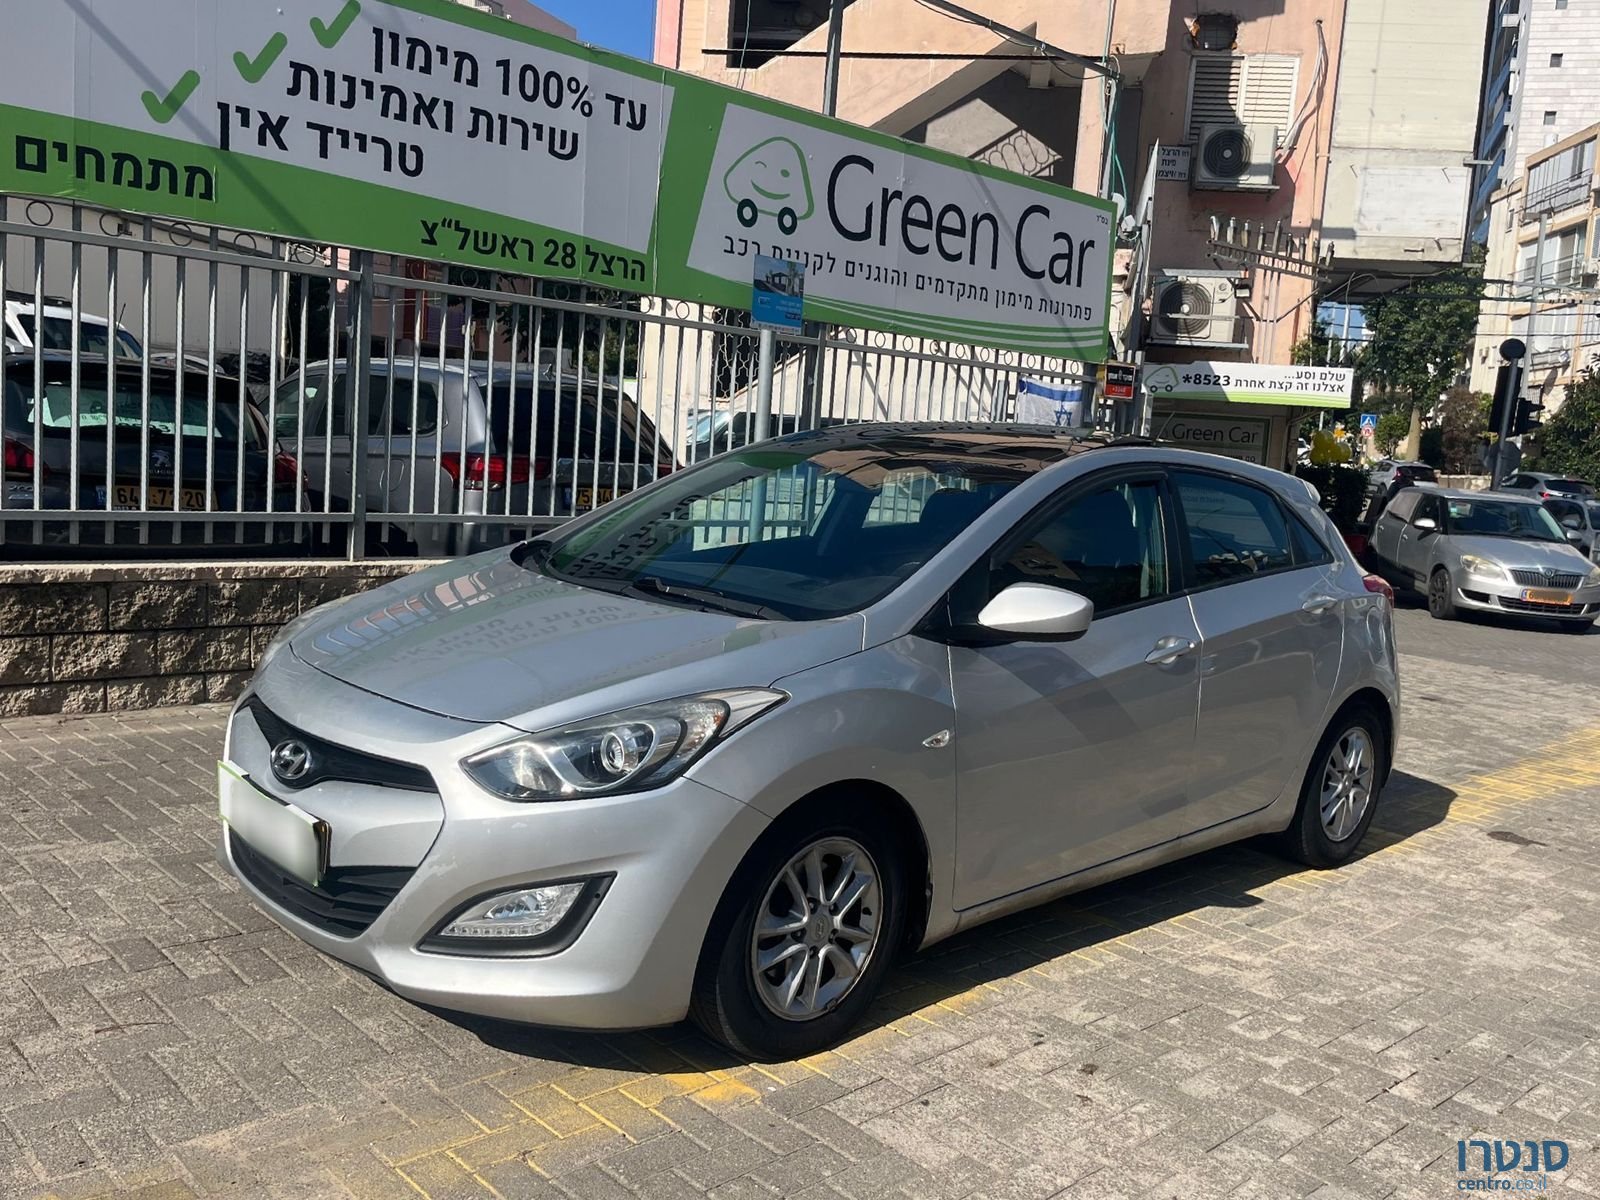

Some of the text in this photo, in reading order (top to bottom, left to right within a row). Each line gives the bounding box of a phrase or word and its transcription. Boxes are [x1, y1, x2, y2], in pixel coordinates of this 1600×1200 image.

[372, 26, 647, 131] עד 100% מימון
[286, 60, 579, 161] שירות ואמינות
[217, 101, 424, 178] טרייד אין
[15, 135, 214, 201] מתמחים
[827, 154, 1095, 288] Green Car
[543, 239, 577, 270] 28
[723, 235, 761, 256] רכב
[584, 244, 646, 282] הרצל
[845, 260, 907, 287] והוגנים
[915, 274, 989, 302] מתקדמים
[995, 289, 1033, 310] מימון
[1038, 297, 1092, 321] פתרונות
[1234, 379, 1345, 393] אצלנו זה קצת אחרת
[1320, 369, 1346, 381] שלם
[1172, 423, 1259, 444] Green Car
